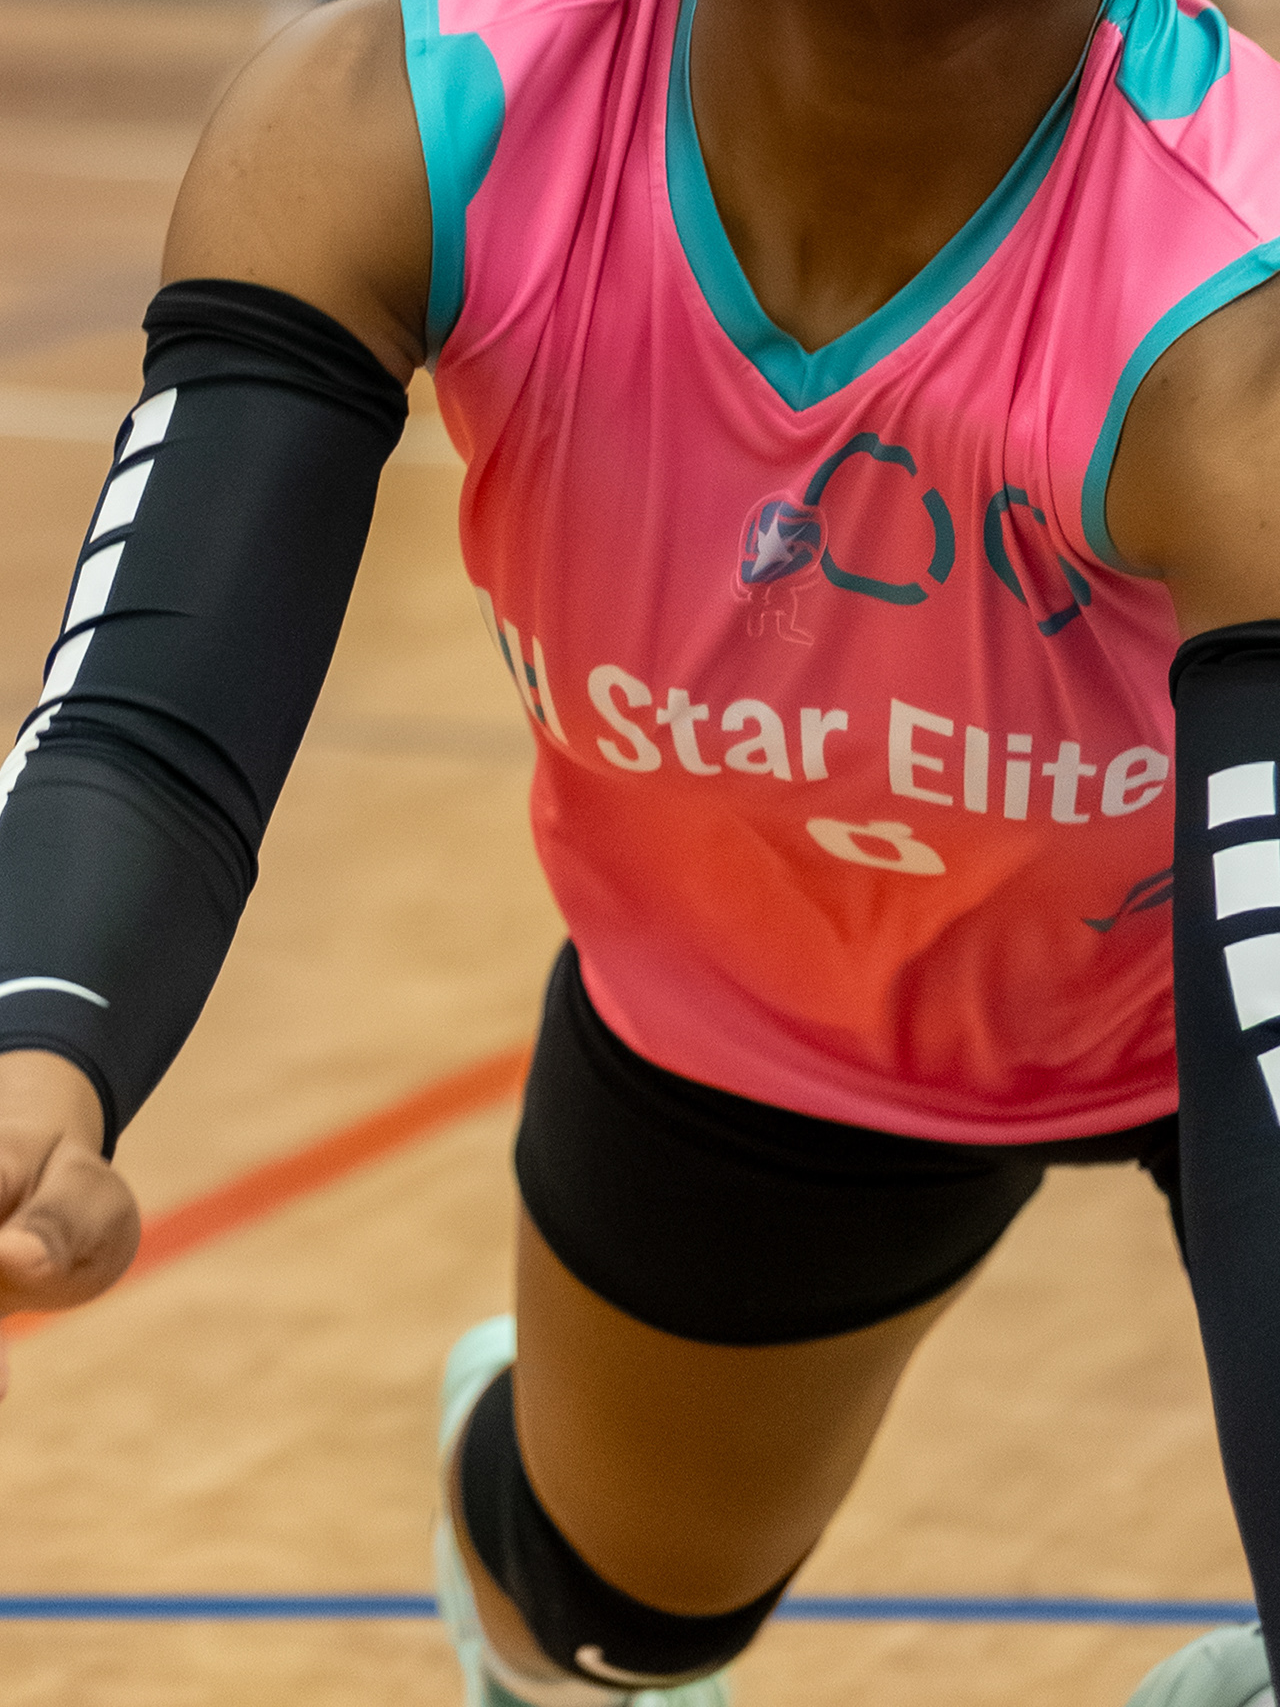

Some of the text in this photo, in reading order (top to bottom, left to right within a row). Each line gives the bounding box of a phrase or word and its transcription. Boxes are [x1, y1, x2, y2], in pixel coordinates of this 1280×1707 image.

[587, 664, 848, 782] Star
[888, 697, 1170, 824] Elite
[805, 816, 948, 876] 6
